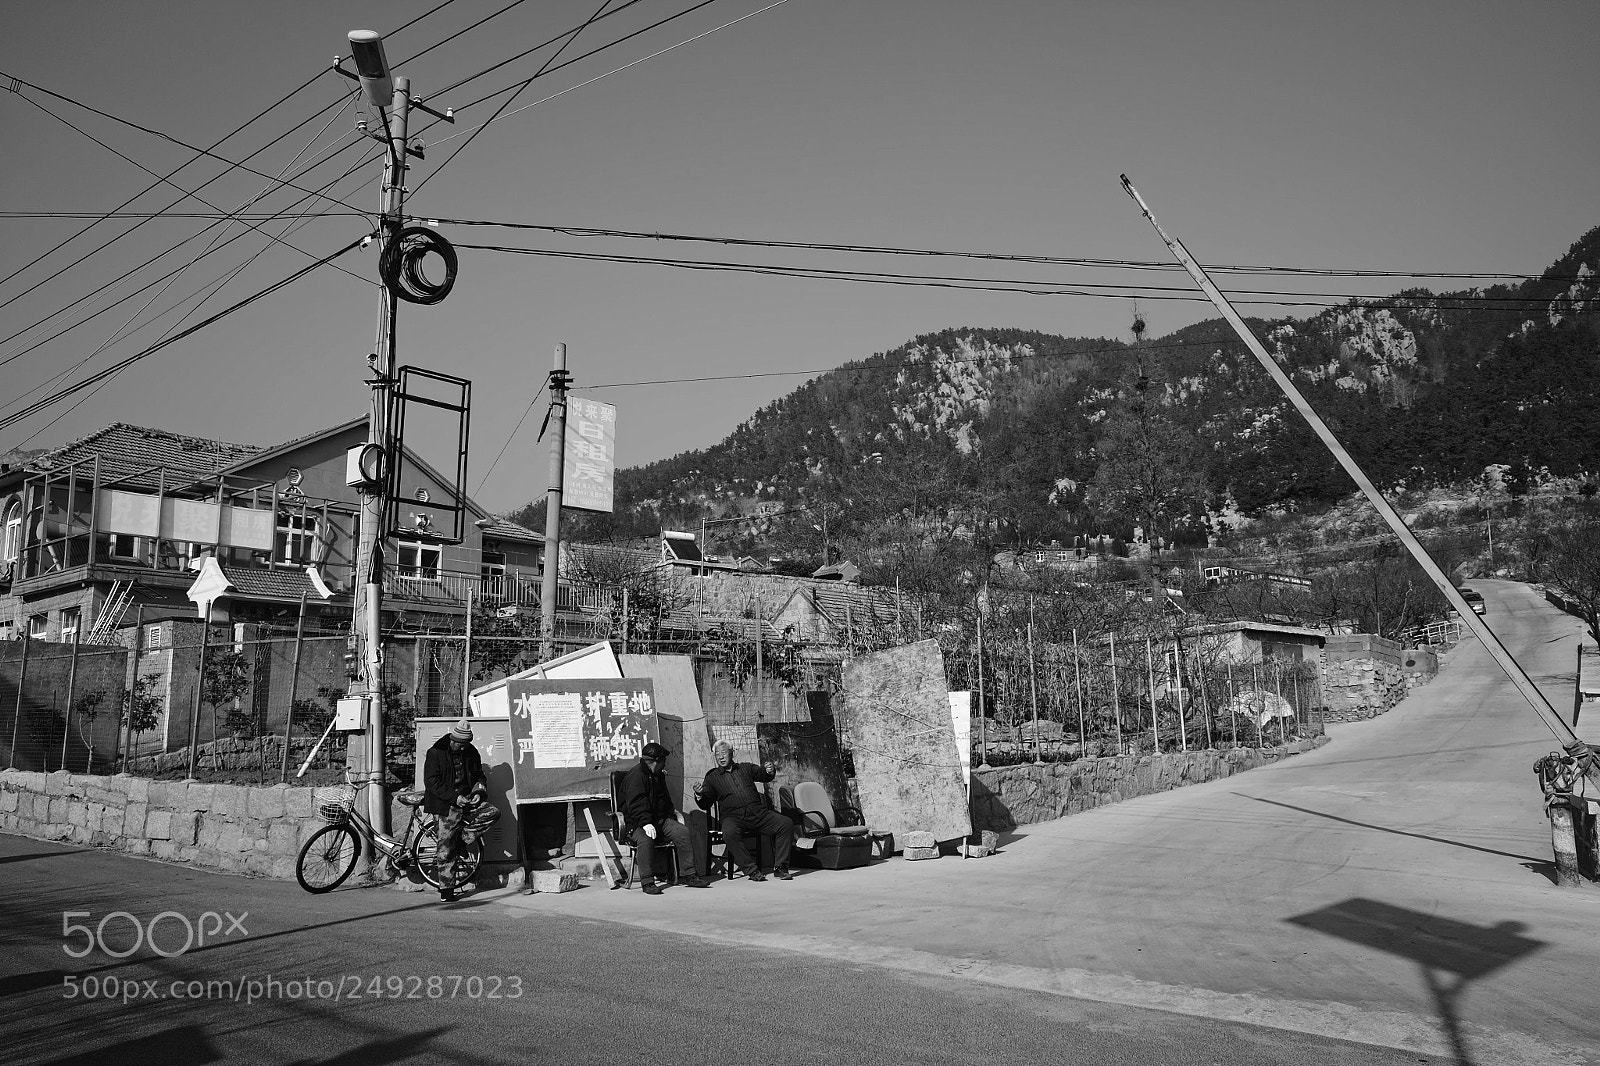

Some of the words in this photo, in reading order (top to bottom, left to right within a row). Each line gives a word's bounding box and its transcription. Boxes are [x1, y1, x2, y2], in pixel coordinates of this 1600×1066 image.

[573, 401, 613, 423] 悦来聚
[571, 420, 609, 483] 日租房
[513, 691, 653, 719] 水护重地
[517, 733, 655, 764] 严辆进
